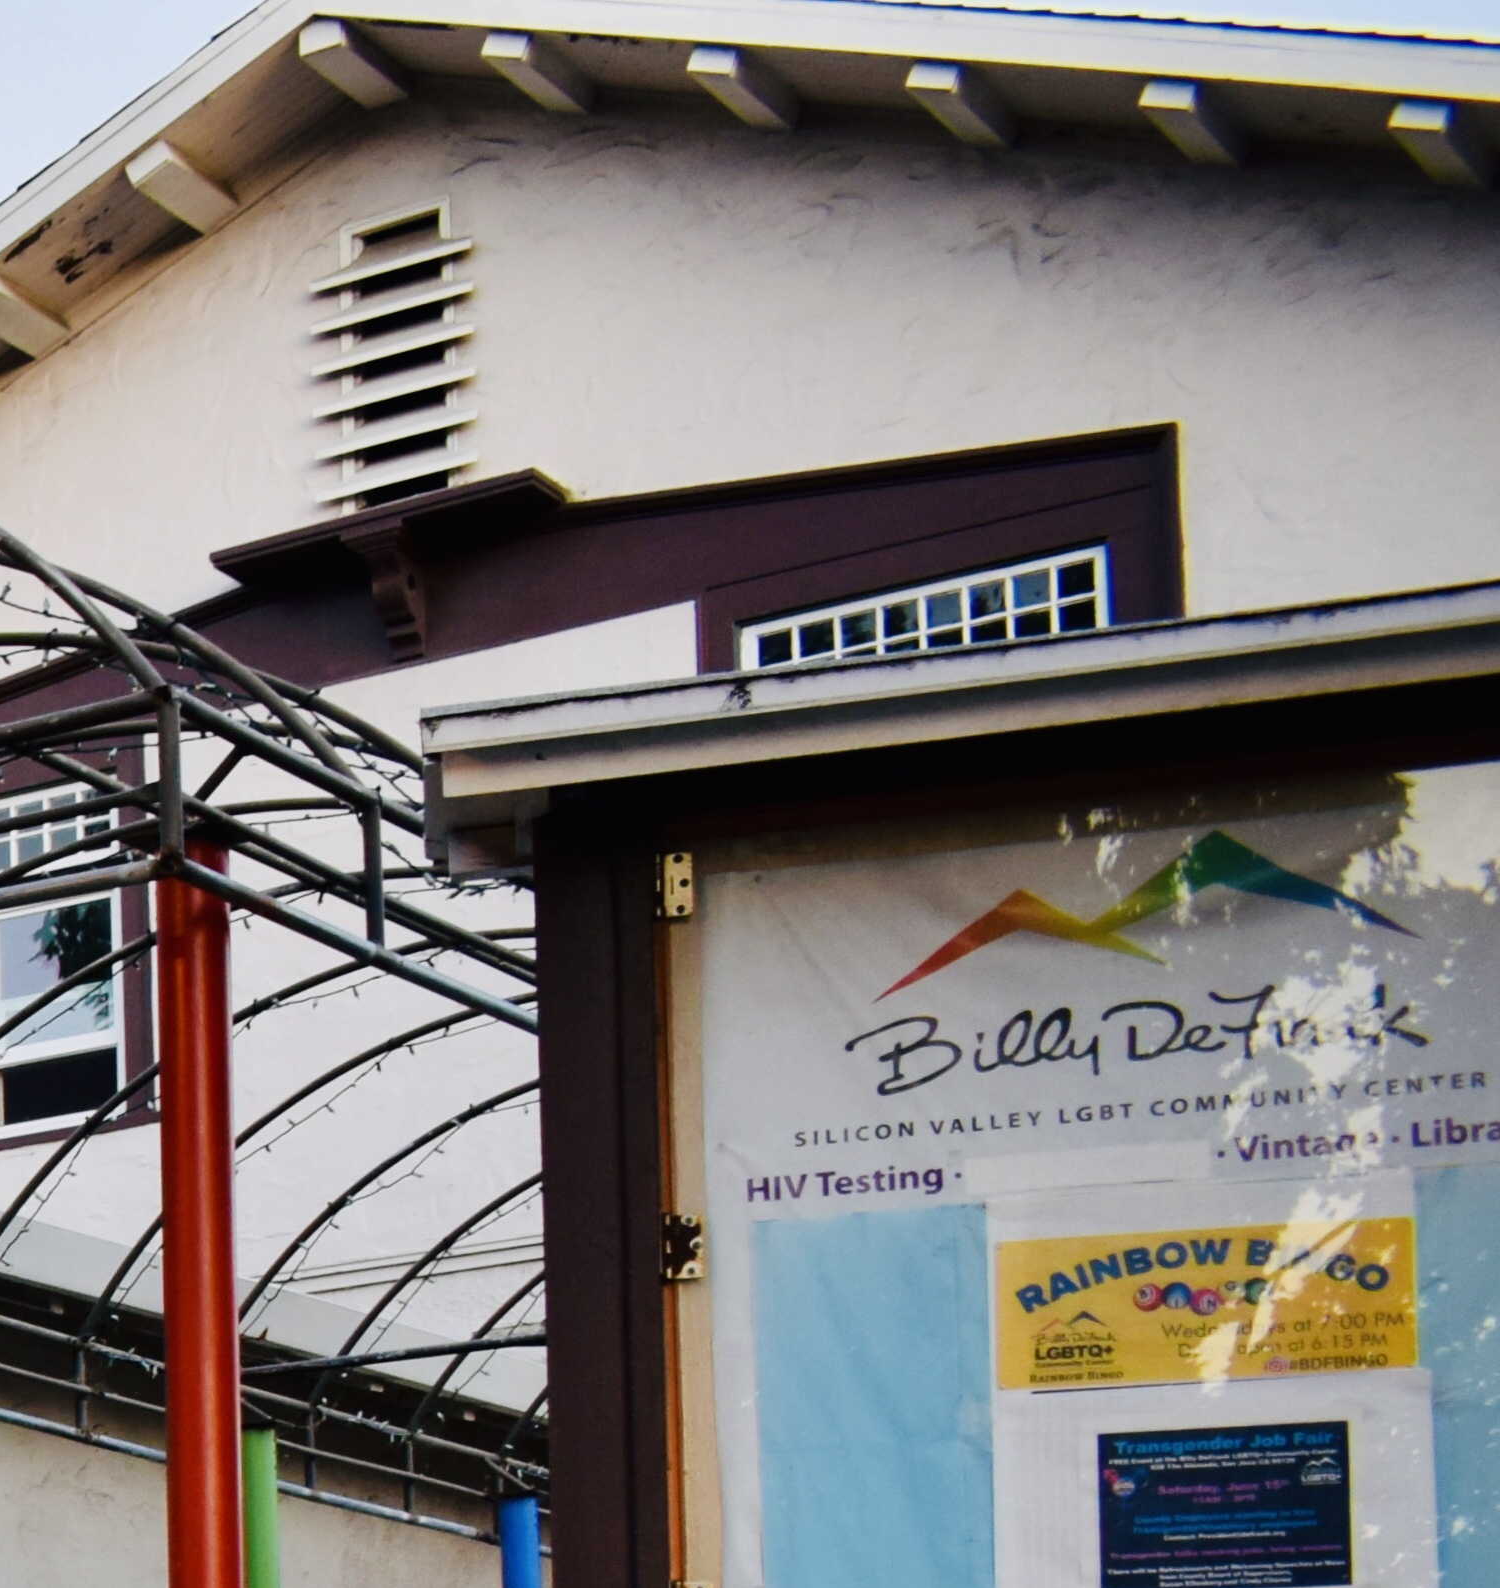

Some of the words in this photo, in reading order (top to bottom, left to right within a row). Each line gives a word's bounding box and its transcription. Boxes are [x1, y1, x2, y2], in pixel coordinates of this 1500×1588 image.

[844, 1007, 1101, 1096] Billy
[795, 1122, 915, 1148] SILICON
[930, 1110, 1042, 1136] VALLEY
[1058, 1102, 1134, 1125] LGBT
[1364, 1072, 1488, 1097] CENTER
[747, 1174, 807, 1203] HIV
[815, 1165, 944, 1195] Testing
[1015, 1238, 1232, 1314] RAINBOW
[1246, 1239, 1390, 1292] BGO
[1375, 1312, 1405, 1327] PM
[1034, 1344, 1115, 1361] LGBTQ+
[1312, 1337, 1354, 1352] 6:15
[1361, 1333, 1388, 1347] PM
[1113, 1436, 1243, 1456] Transgender
[1250, 1431, 1286, 1448] Job
[1293, 1430, 1334, 1445] Fair
